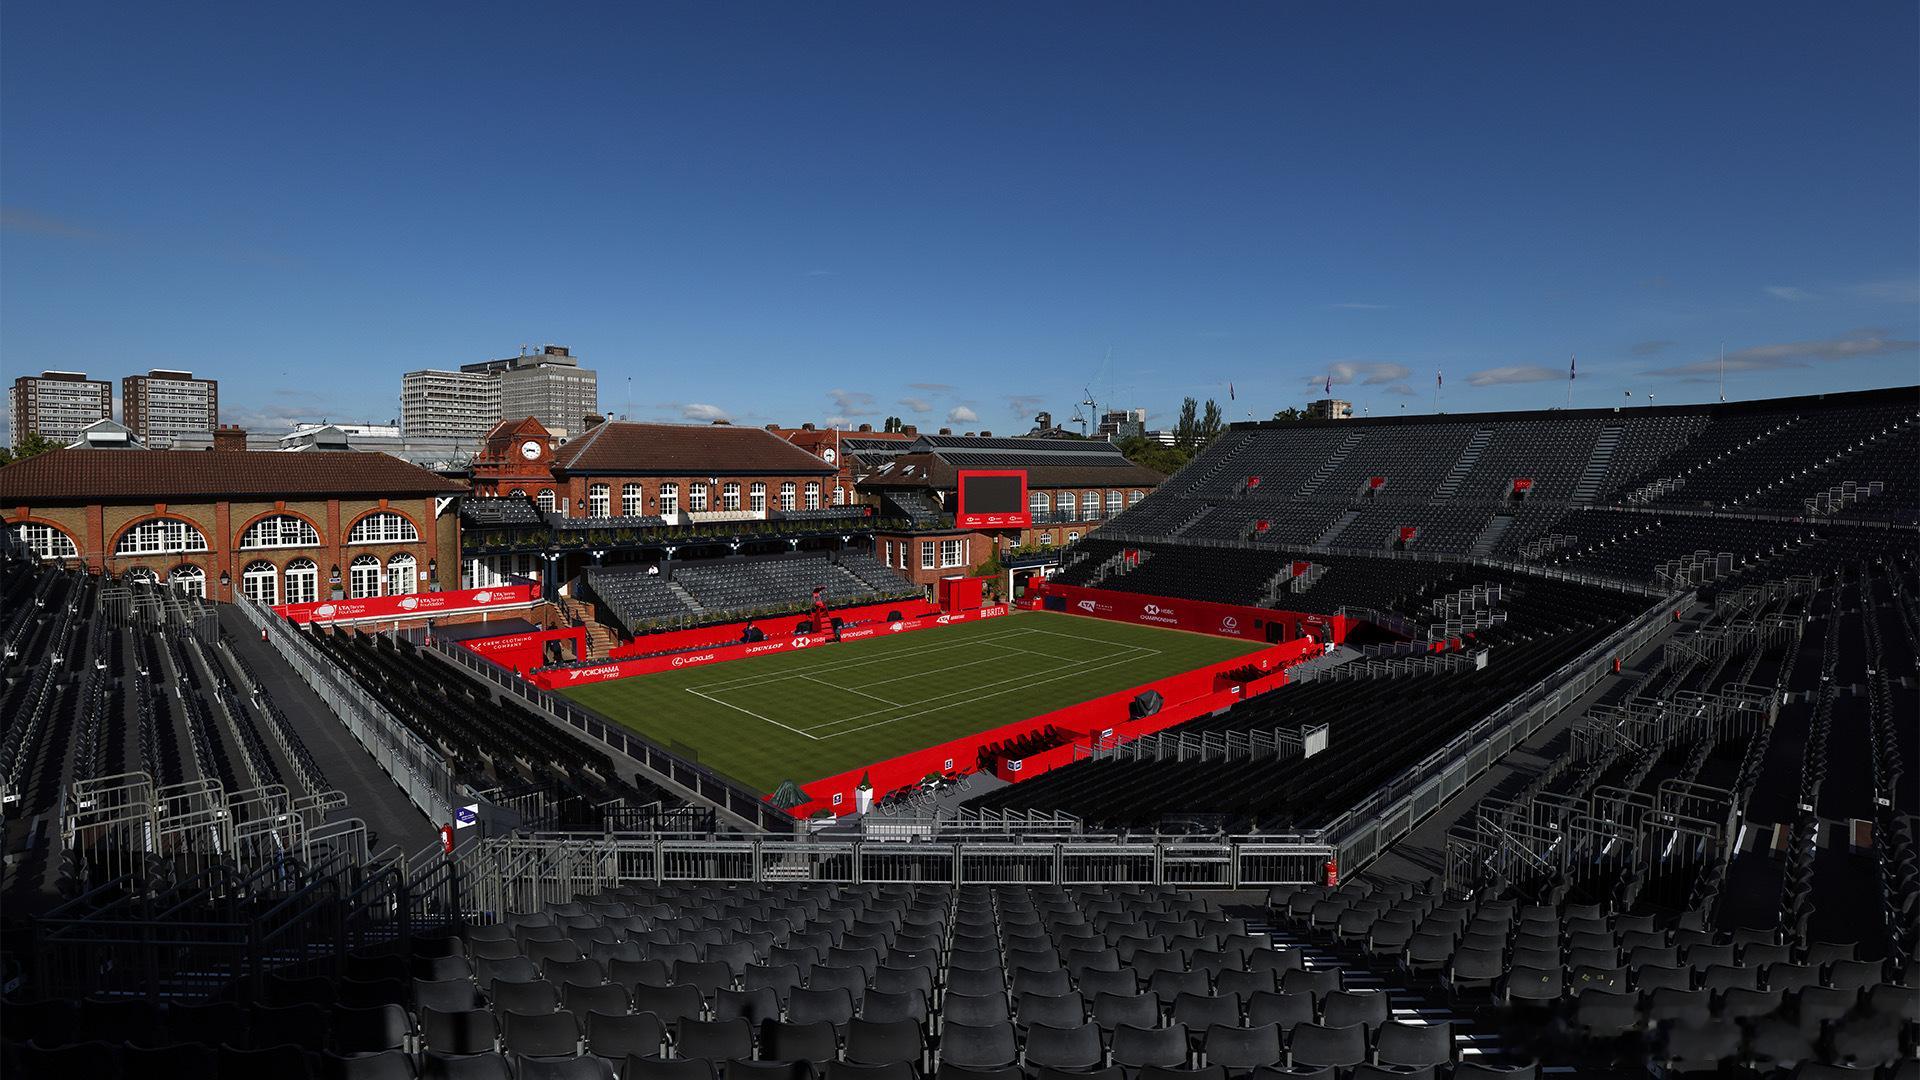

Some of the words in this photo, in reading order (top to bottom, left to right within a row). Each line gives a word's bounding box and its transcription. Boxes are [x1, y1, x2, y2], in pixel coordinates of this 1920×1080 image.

[986, 606, 1005, 616] BRITA
[1081, 602, 1093, 611] LTA
[1140, 615, 1178, 624] CHAMPIONSHIPS
[502, 636, 532, 644] CLOTHING
[493, 642, 522, 650] COMPANY
[751, 643, 784, 653] DUNLOP
[684, 653, 714, 664] LEXUS
[581, 665, 620, 677] YOKOHAMA
